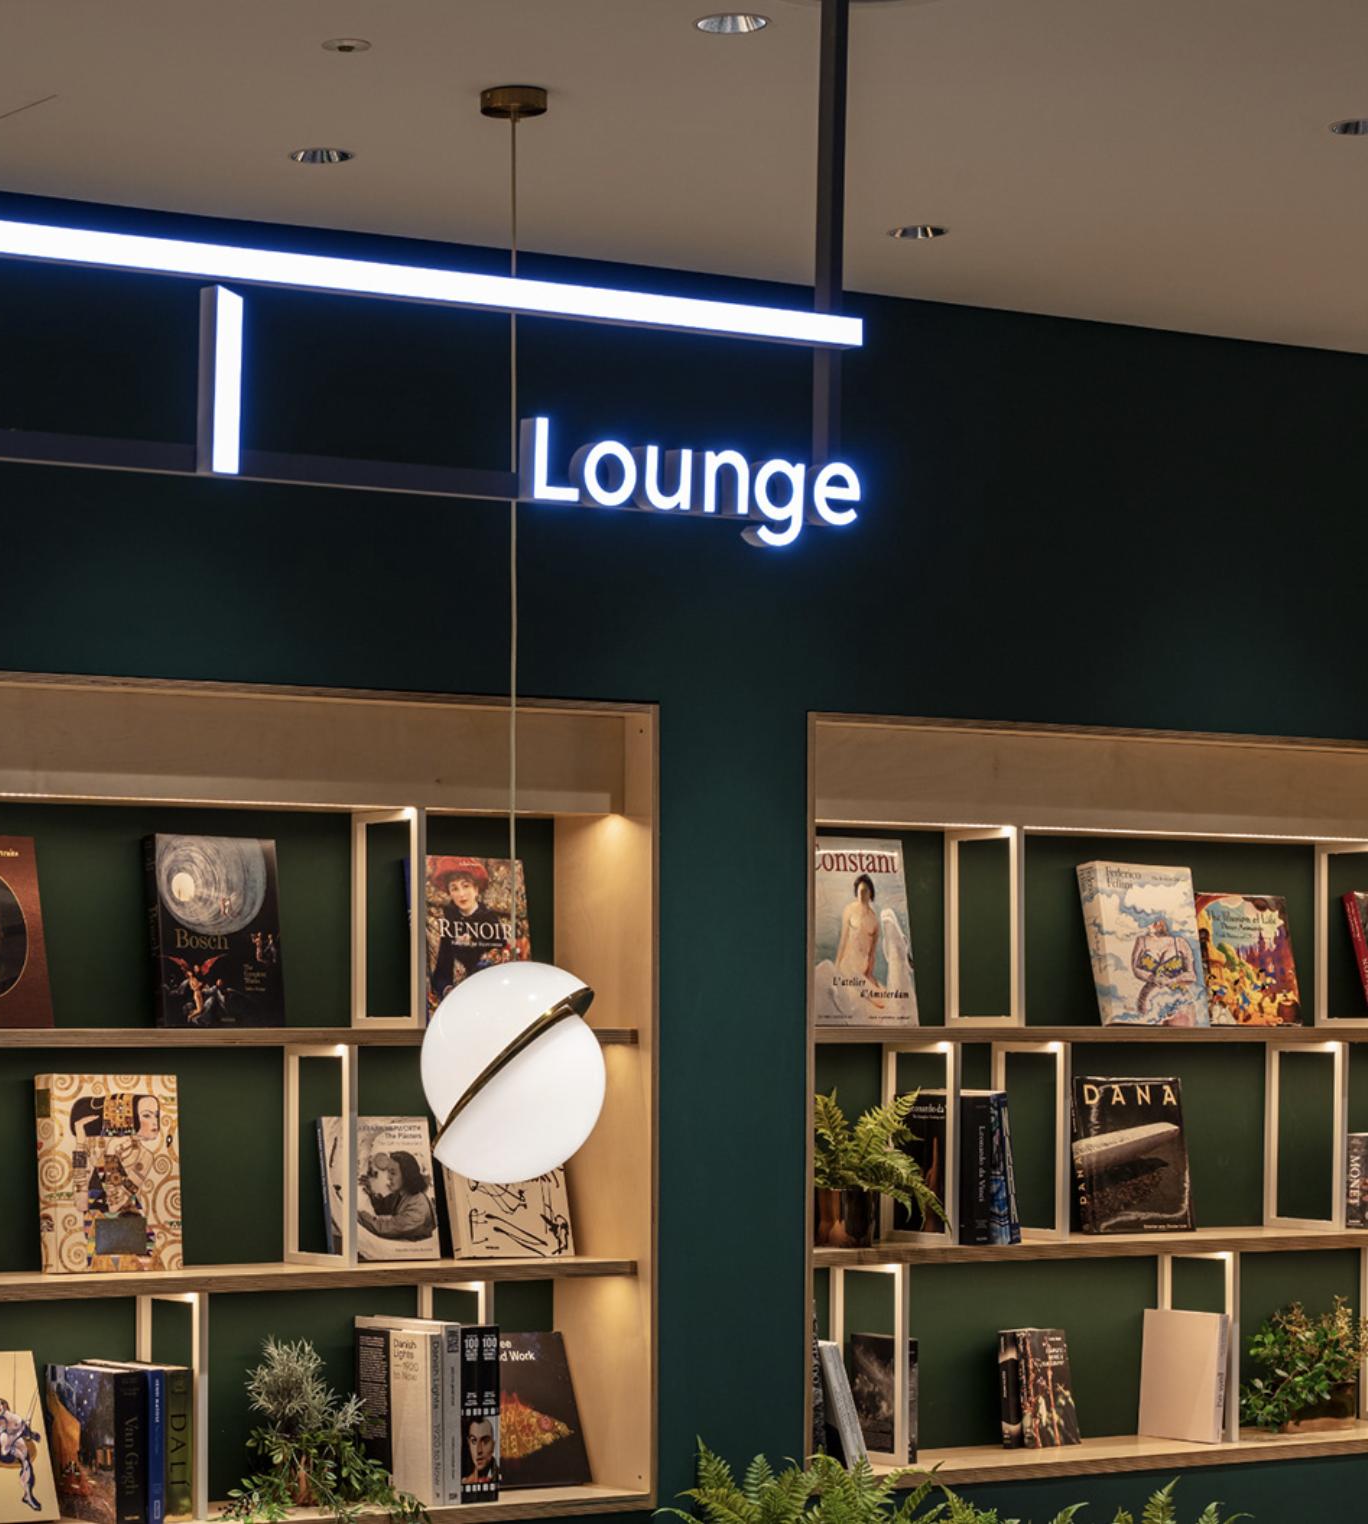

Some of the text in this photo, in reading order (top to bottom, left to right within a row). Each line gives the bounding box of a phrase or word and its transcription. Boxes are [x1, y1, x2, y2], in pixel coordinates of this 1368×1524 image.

[530, 416, 862, 547] Lounge
[1105, 865, 1142, 880] Federico
[175, 928, 229, 950] Bosch
[438, 918, 512, 940] RENOIR
[832, 976, 866, 987] L'atelier
[860, 989, 910, 999] d'Amsterdam
[1083, 1083, 1178, 1106] DANA
[978, 1125, 987, 1203] Leonardo da Vinci
[1349, 1155, 1361, 1206] MONET
[393, 1338, 417, 1349] Danish
[464, 1337, 479, 1349] 100
[482, 1336, 498, 1348] 100
[393, 1349, 415, 1360] Lights
[509, 1350, 536, 1361] Work
[431, 1378, 440, 1409] Lights
[121, 1416, 139, 1496] Van Gogh
[170, 1413, 190, 1487] DALÍ
